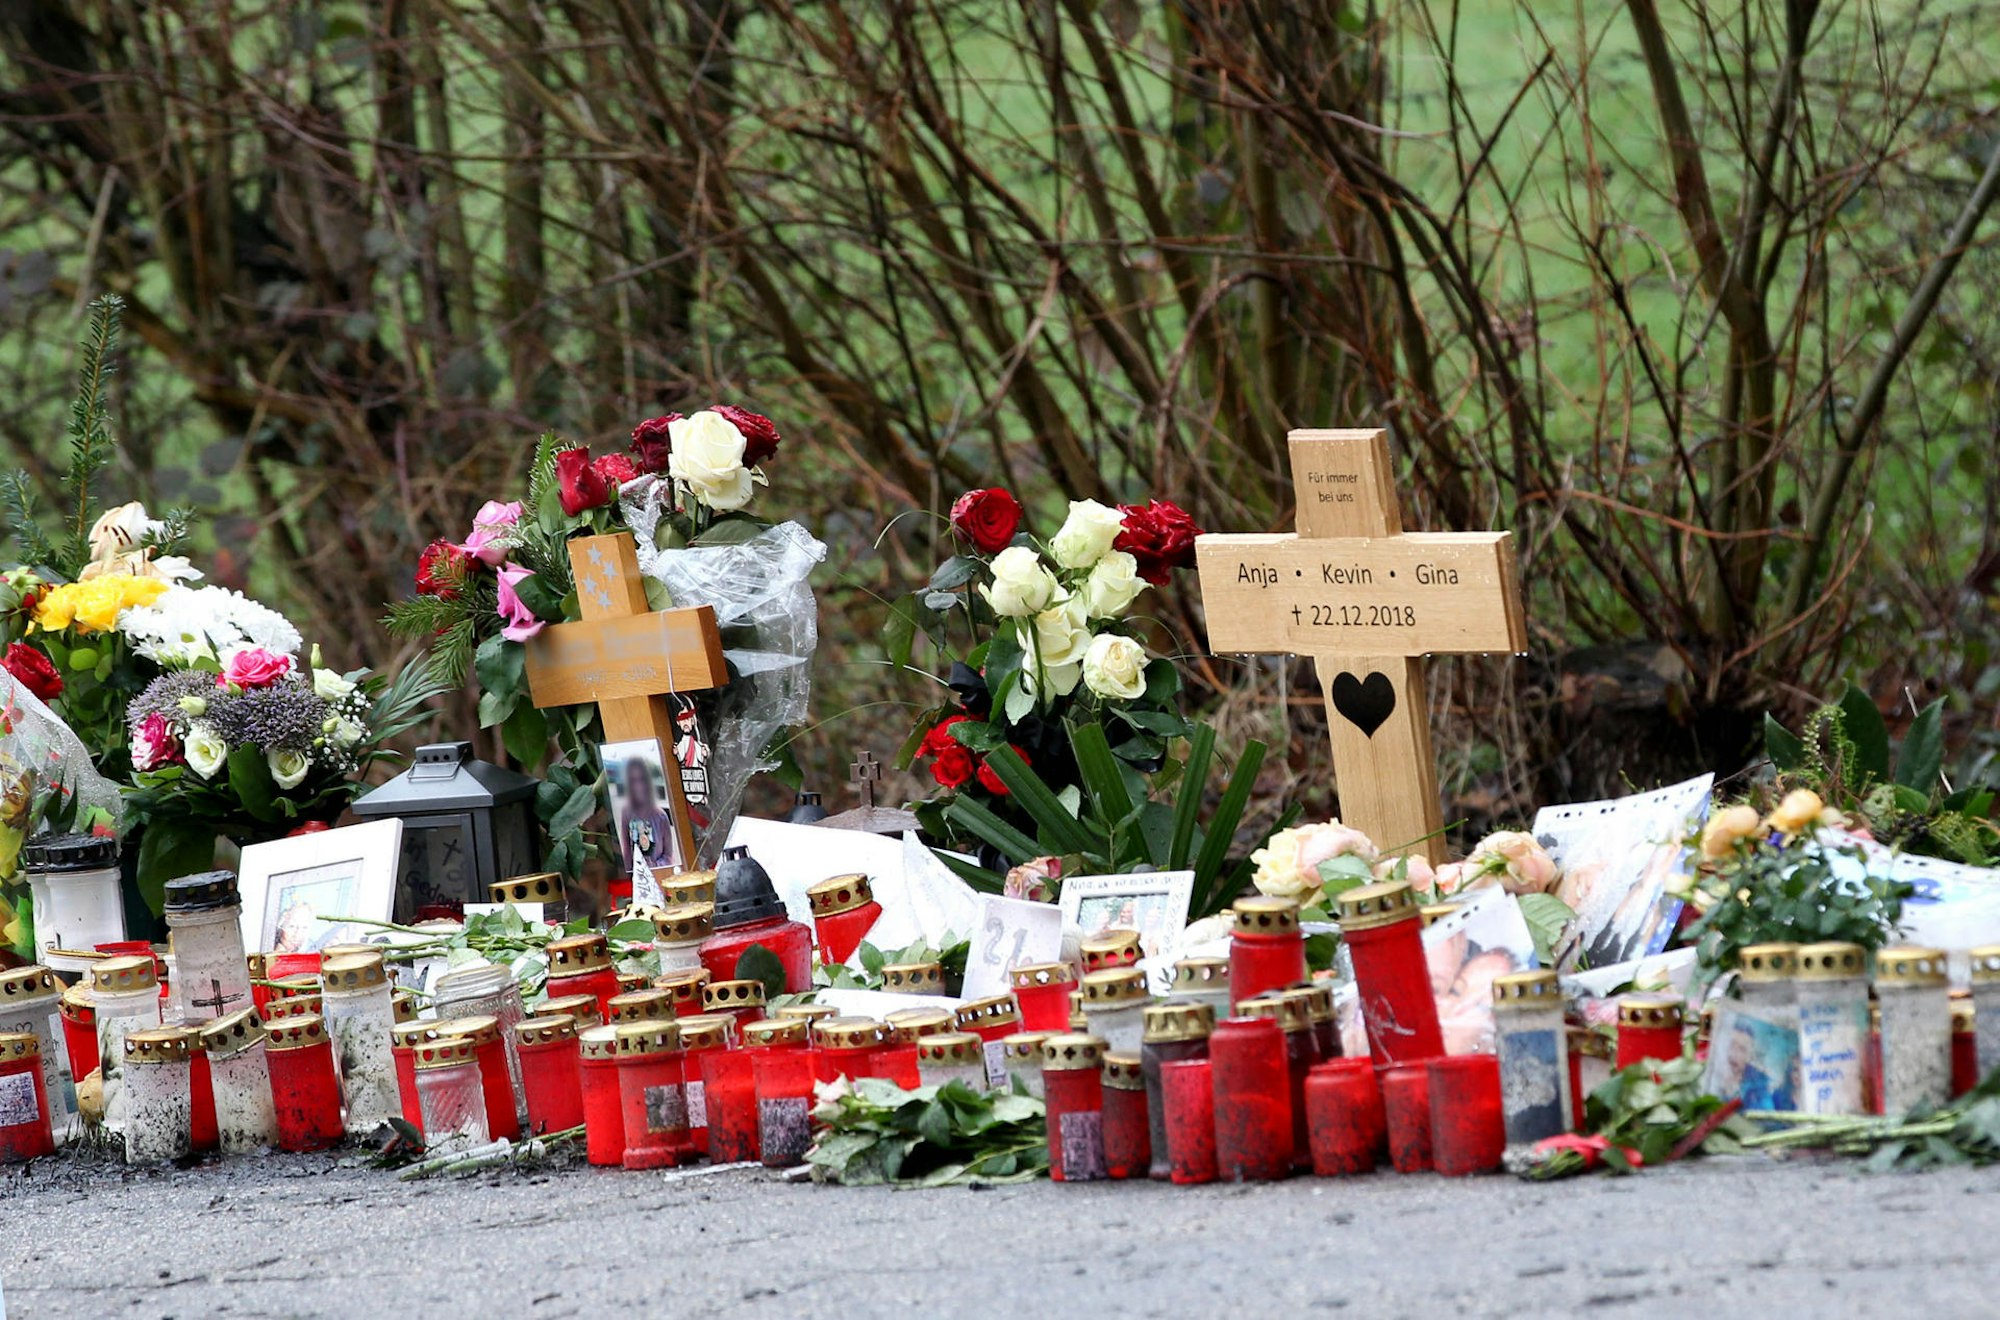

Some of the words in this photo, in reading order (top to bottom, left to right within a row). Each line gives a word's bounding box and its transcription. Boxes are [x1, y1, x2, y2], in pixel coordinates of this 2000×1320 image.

[1308, 472, 1324, 484] Für
[1326, 472, 1358, 484] immer
[1318, 491, 1334, 503] bei
[1335, 493, 1354, 503] uns
[1238, 562, 1278, 589] Anja
[1322, 563, 1373, 584] Kevin
[1415, 563, 1459, 585] Gina
[1310, 605, 1416, 627] 22.12.2018
